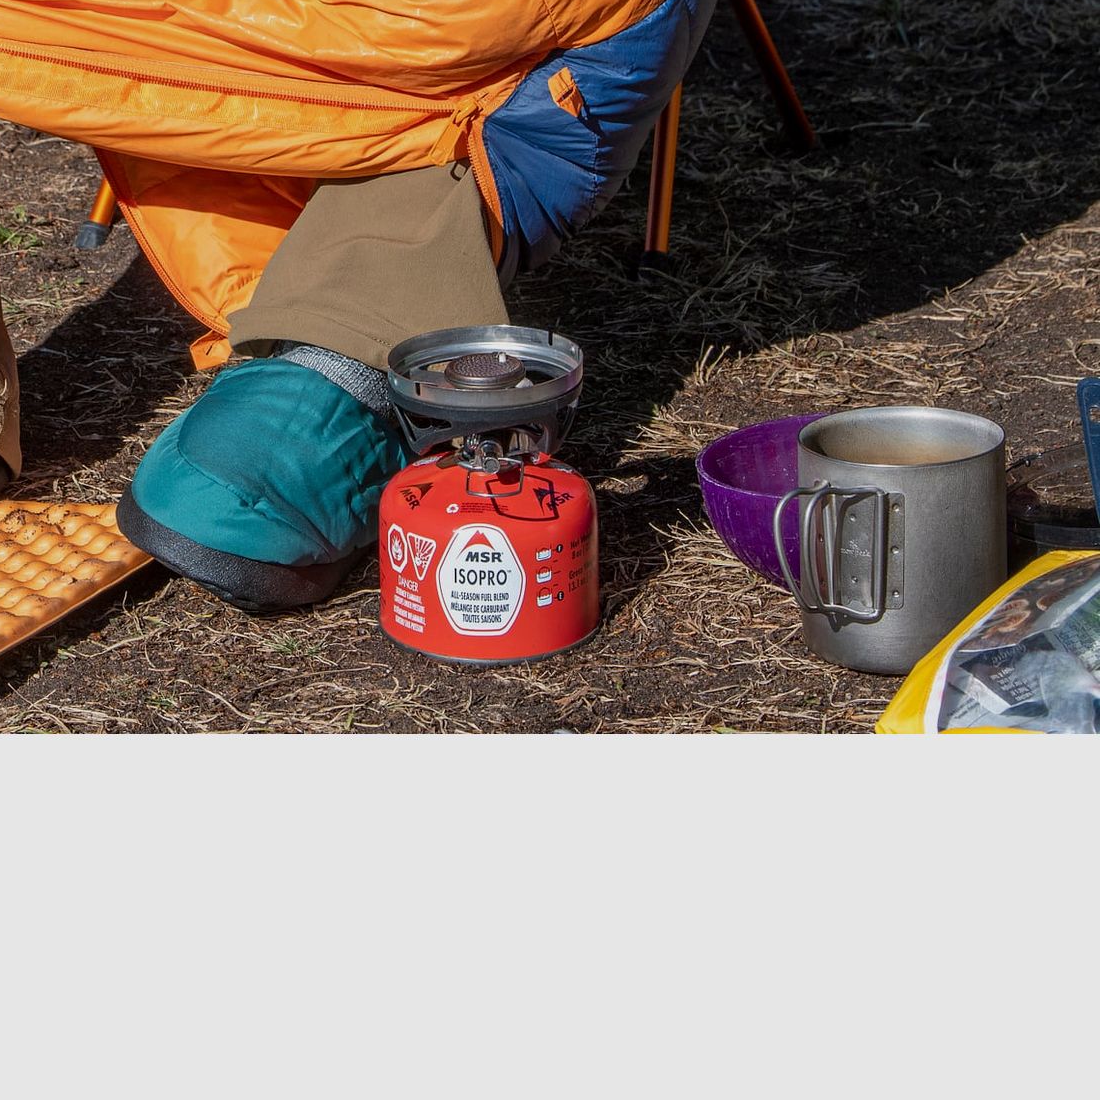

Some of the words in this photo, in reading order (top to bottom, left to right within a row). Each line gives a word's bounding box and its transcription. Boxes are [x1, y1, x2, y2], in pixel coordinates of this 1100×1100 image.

[400, 488, 420, 511] MSR
[465, 551, 503, 563] MSR
[454, 567, 508, 586] ISOPRO
[451, 590, 480, 601] ALL-SEASON
[481, 593, 493, 602] FUEL
[493, 592, 510, 601] BLEND
[473, 604, 480, 613] DE
[480, 603, 510, 614] CARBURANT
[462, 613, 480, 623] TOUTES
[480, 614, 502, 623] SAISONS
